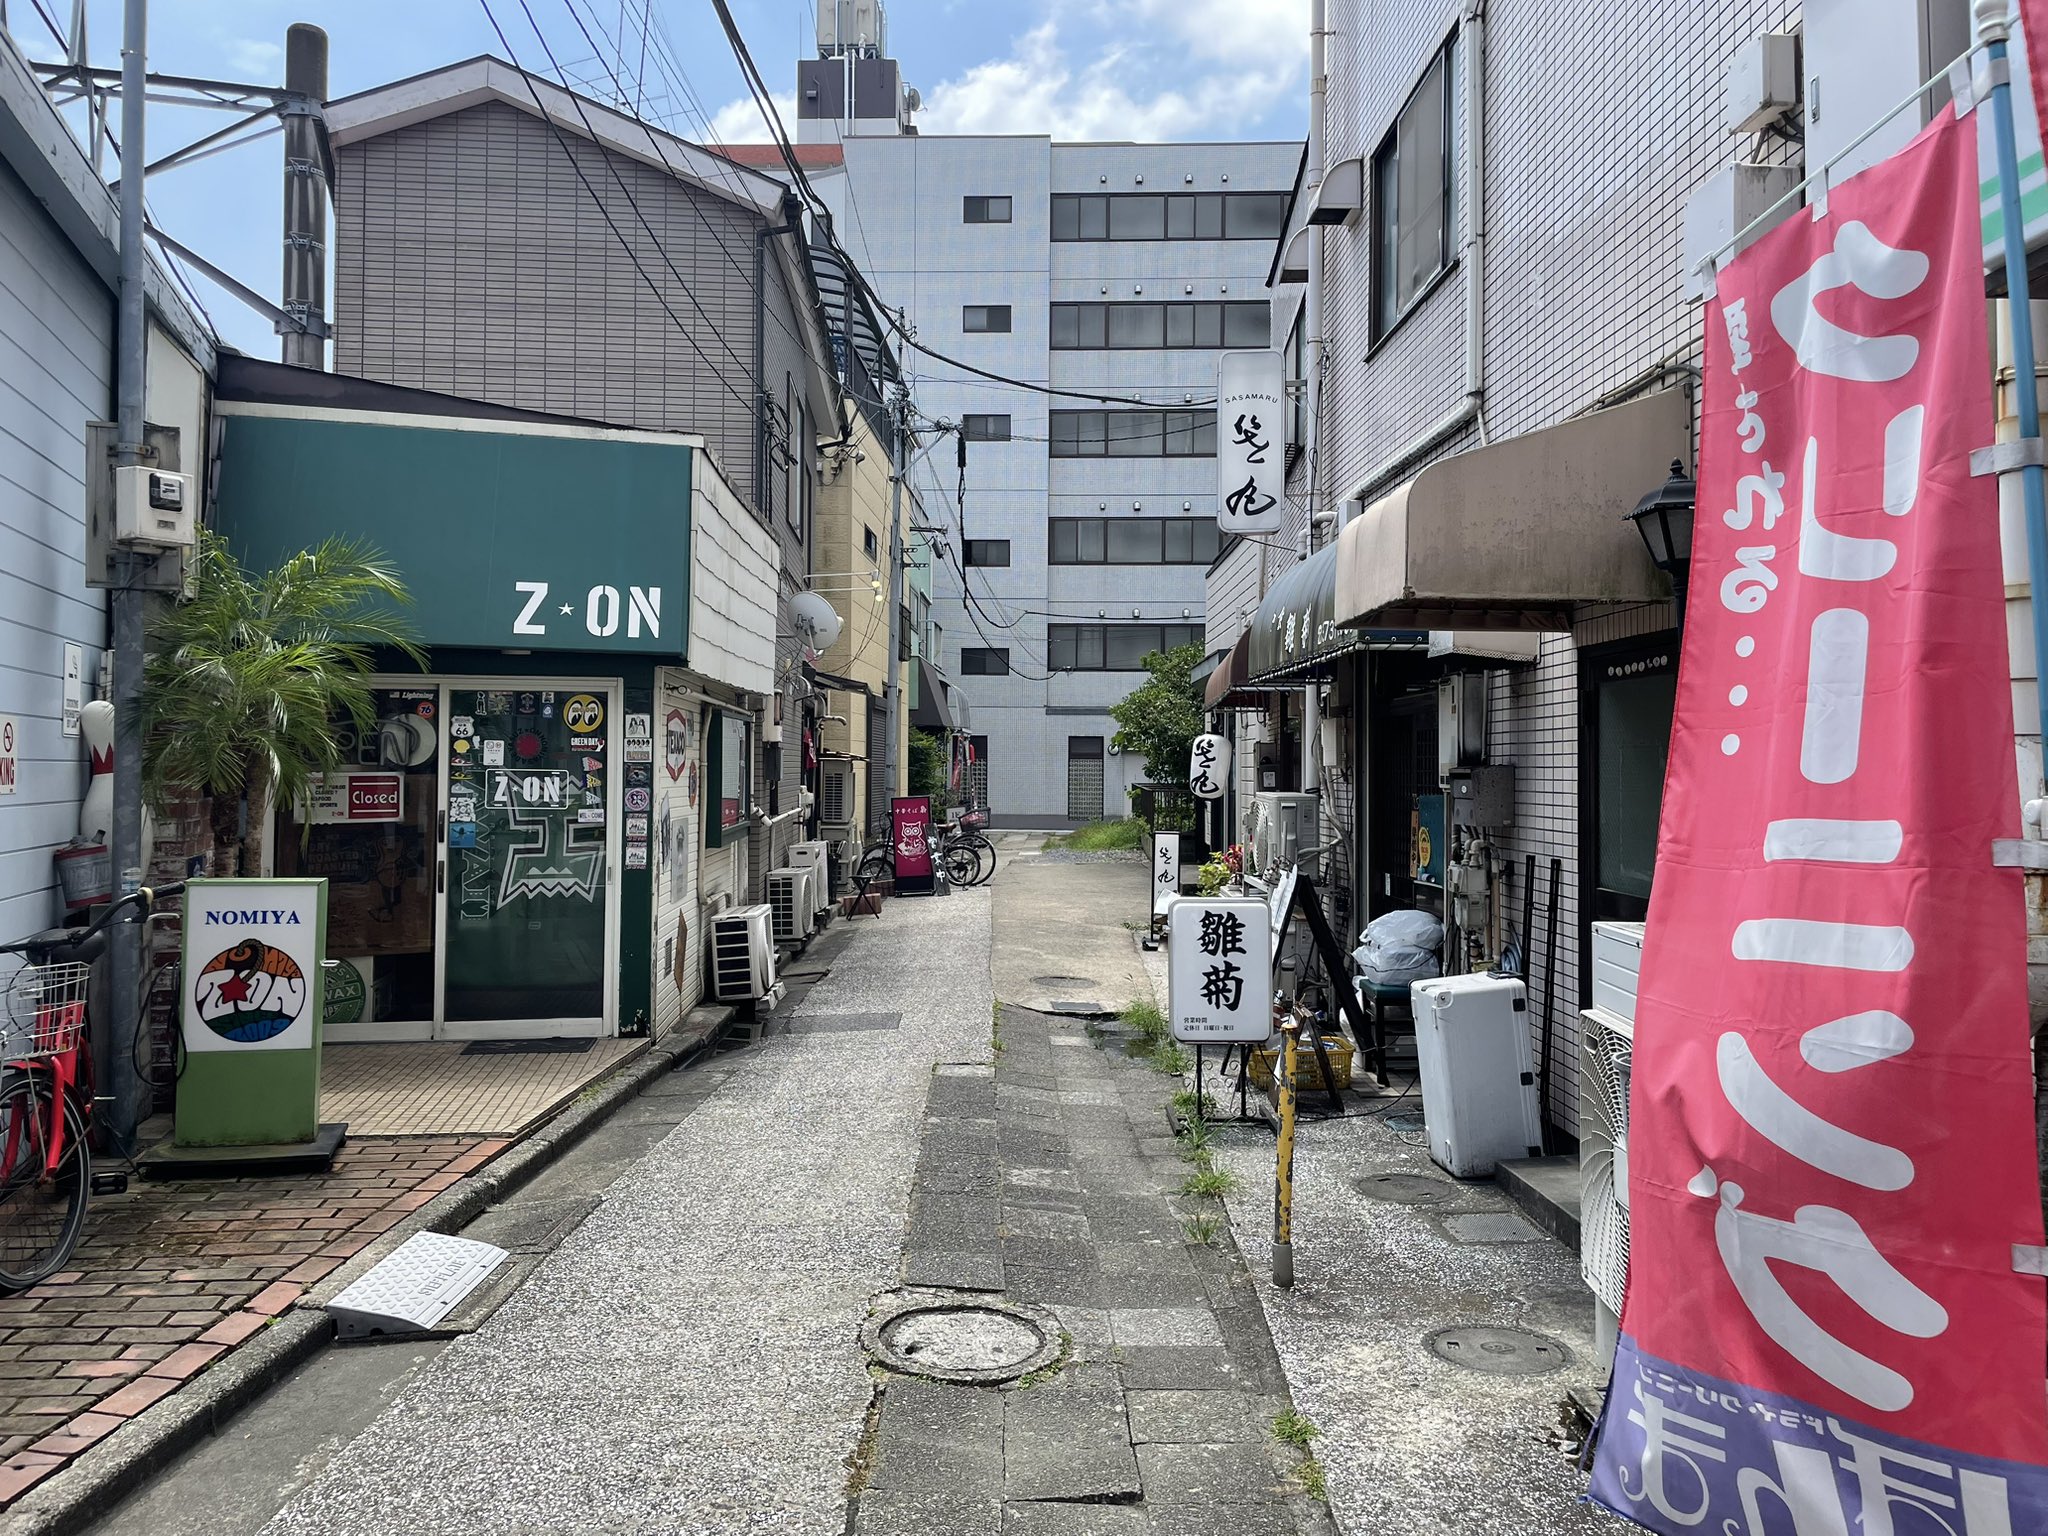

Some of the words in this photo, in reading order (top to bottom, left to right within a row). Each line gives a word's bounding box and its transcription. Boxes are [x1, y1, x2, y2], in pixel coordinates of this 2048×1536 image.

[1225, 393, 1278, 404] SASAMARU
[586, 585, 661, 639] ON
[402, 691, 434, 700] Lightning
[420, 705, 432, 714] 76
[455, 728, 469, 736] 66
[571, 737, 588, 746] GREEN
[522, 776, 561, 803] ON
[352, 790, 398, 804] Closed
[205, 910, 301, 925] NOMIYA
[1197, 910, 1247, 1012] 雛菊
